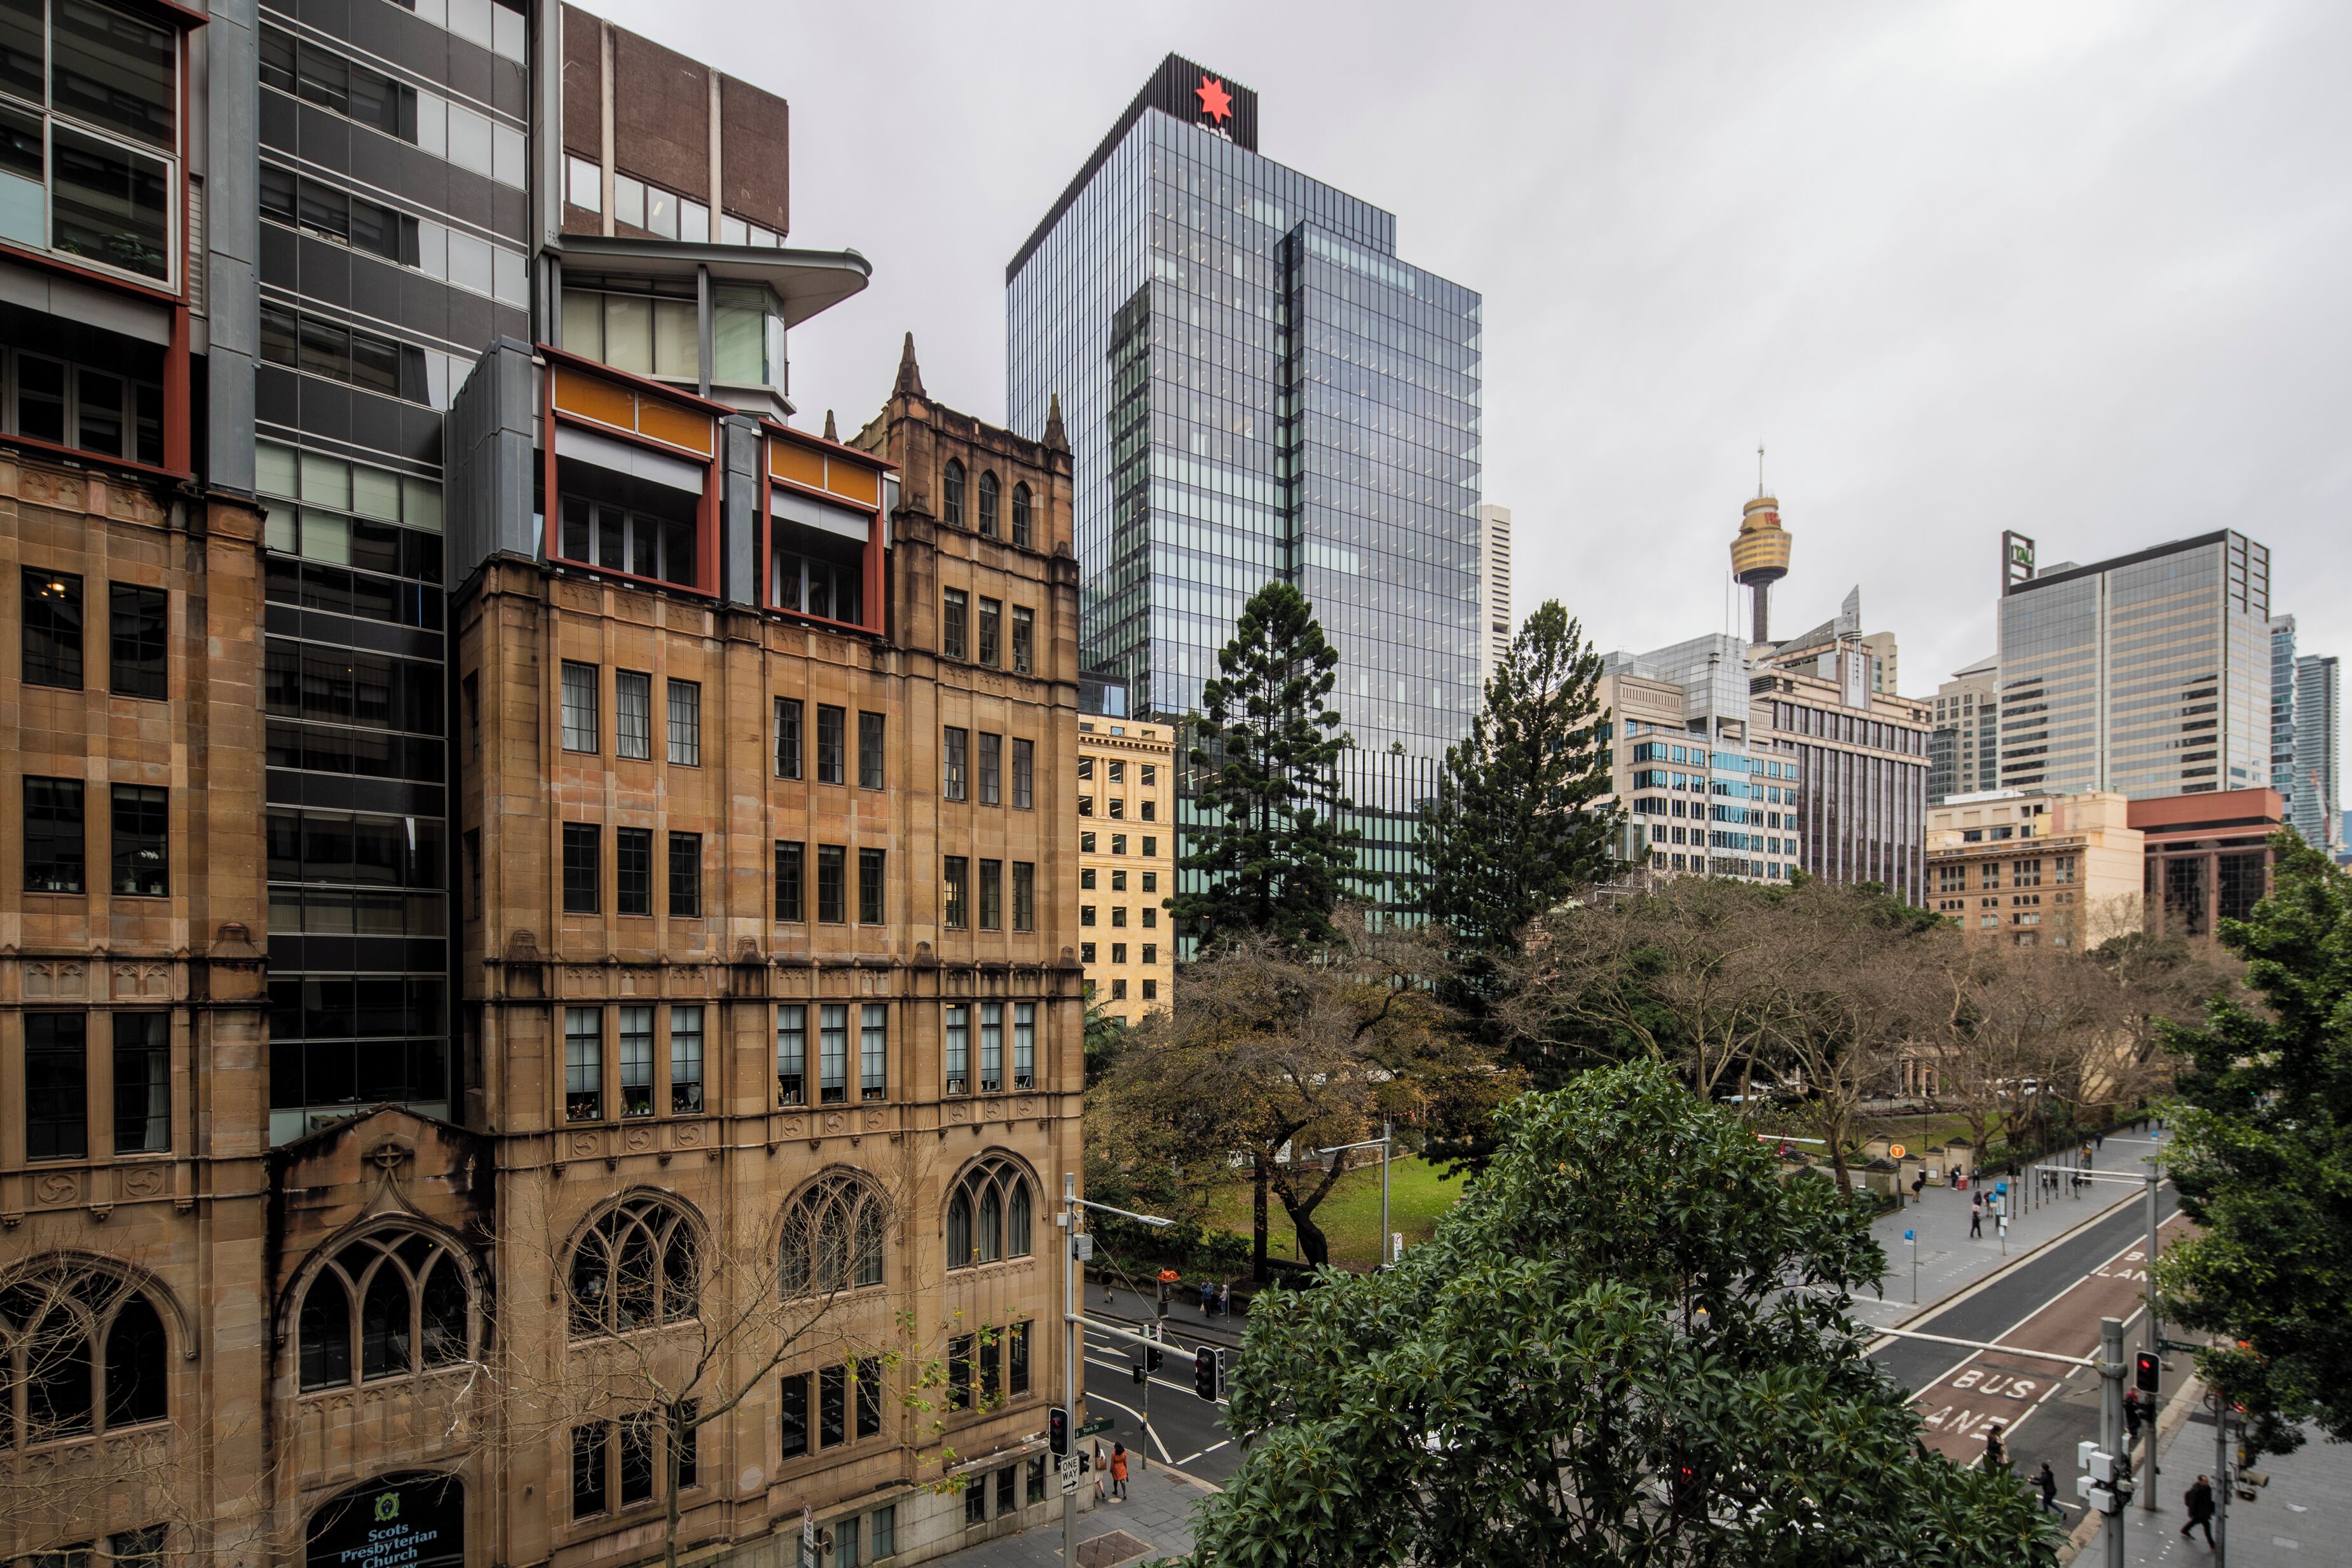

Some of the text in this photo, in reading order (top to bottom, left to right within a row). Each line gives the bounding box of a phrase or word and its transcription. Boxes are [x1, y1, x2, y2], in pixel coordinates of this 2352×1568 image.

[2096, 1266, 2148, 1282] LAN
[1952, 1370, 2036, 1398] BUS
[1925, 1405, 2009, 1441] ANE
[1063, 1459, 1077, 1471] ONE
[1062, 1468, 1077, 1482] WAY
[368, 1524, 409, 1543] Scots
[806, 1522, 812, 1532] NO
[341, 1530, 437, 1563] Presbyterian
[362, 1547, 418, 1568] Church
